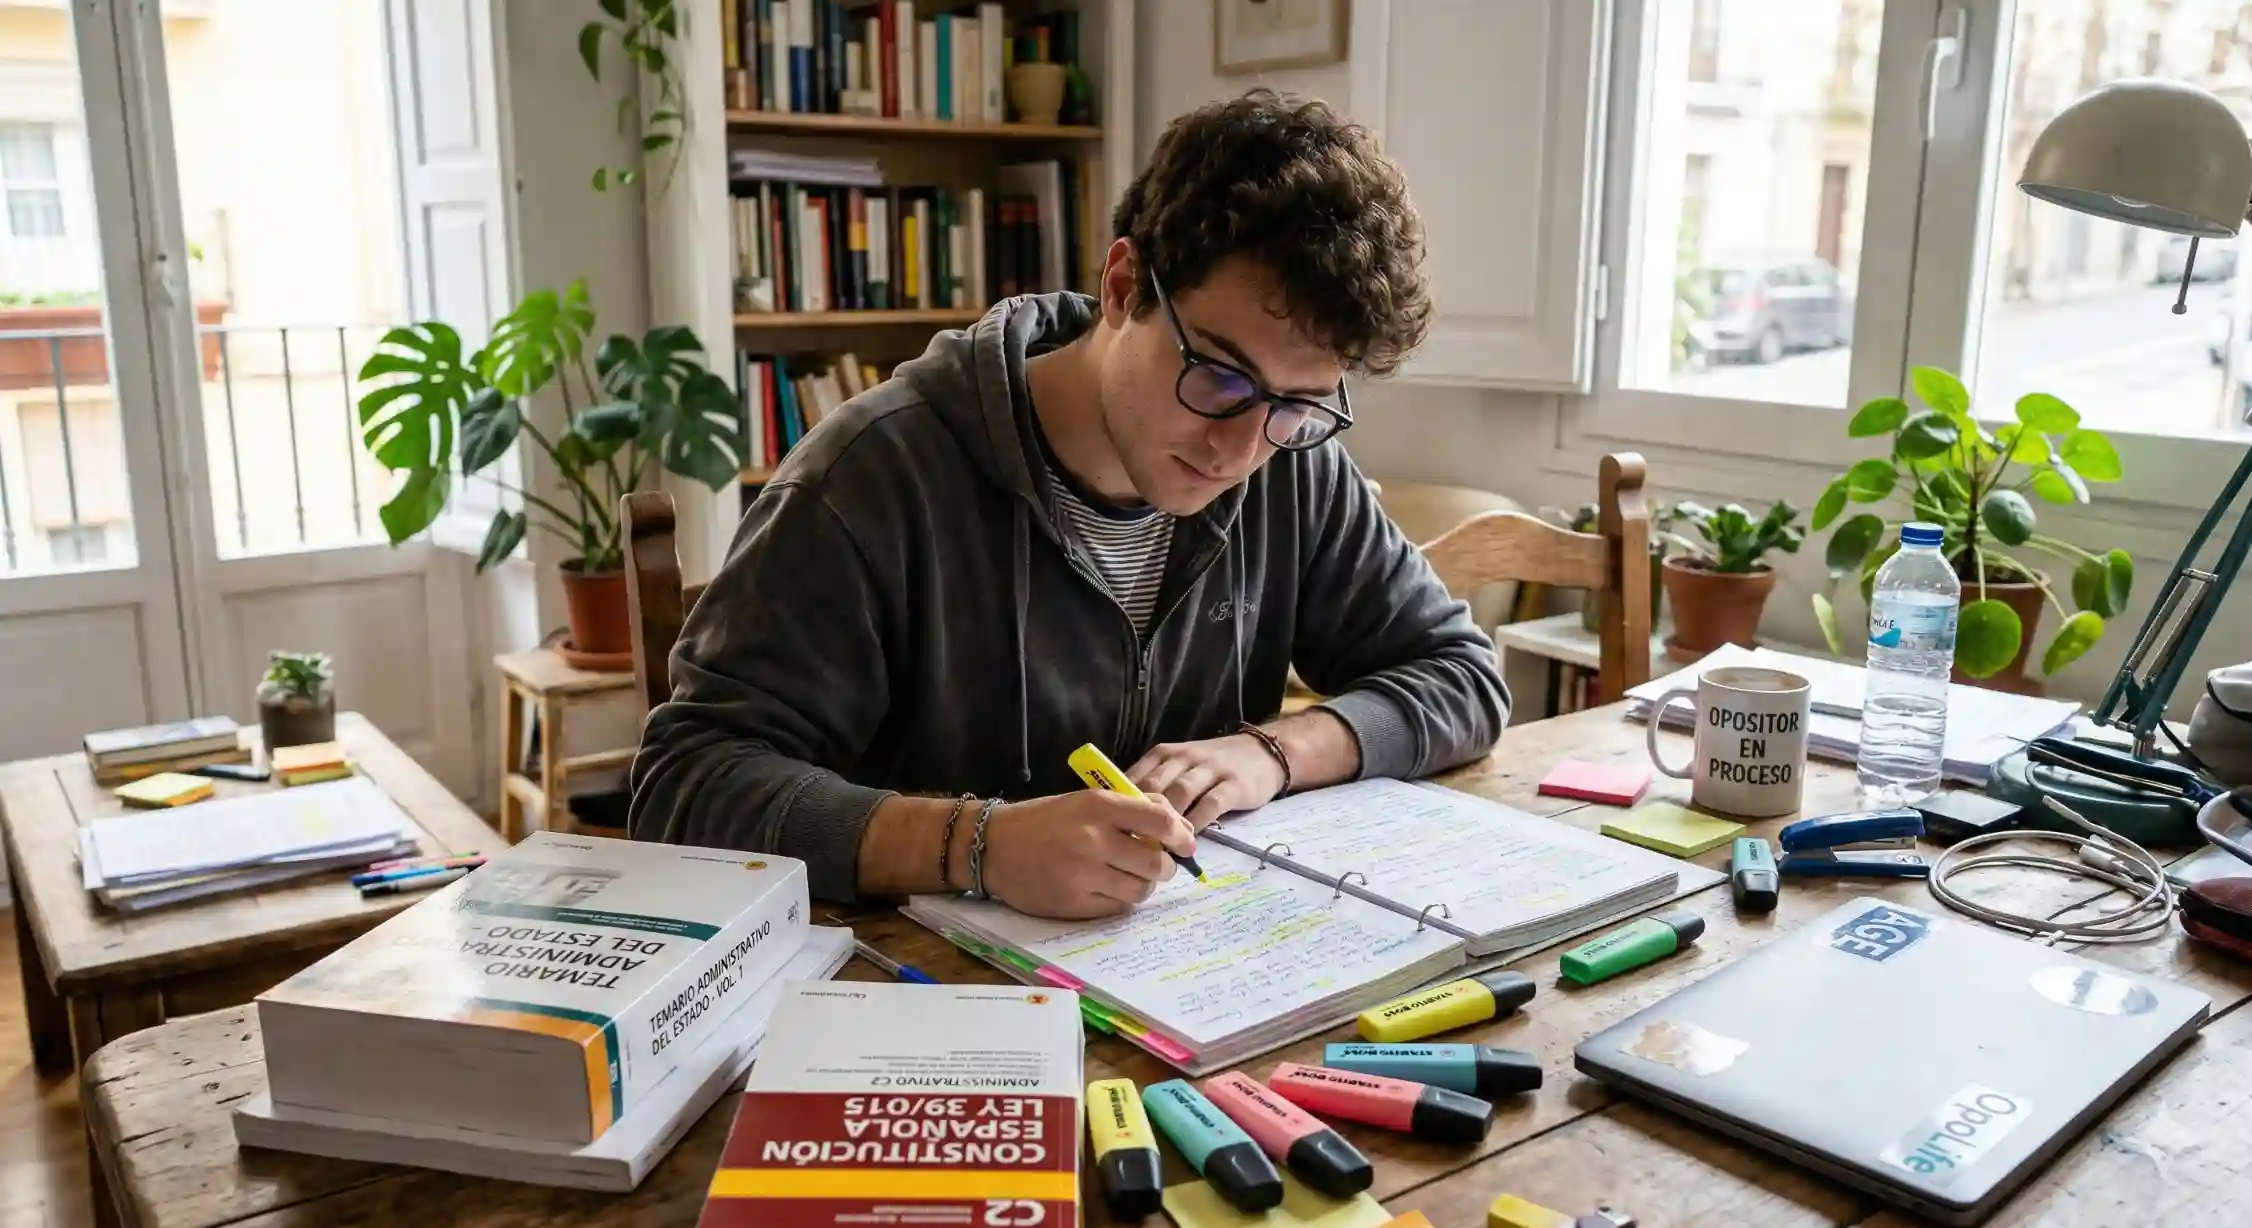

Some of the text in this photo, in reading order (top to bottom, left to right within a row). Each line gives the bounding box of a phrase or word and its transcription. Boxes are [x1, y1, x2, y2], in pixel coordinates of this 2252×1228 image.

[1709, 706, 1799, 734] OPOSITOR
[1740, 738, 1766, 759] EN
[1709, 758, 1793, 785] PROCESO
[487, 926, 603, 947] ESTADO
[612, 937, 666, 956] DEL
[1833, 911, 1925, 957] AGE
[484, 962, 620, 990] TEMARIO
[650, 920, 771, 1034] TEMARIO ADMINISTRATIVO
[651, 1028, 671, 1056] DEL
[673, 995, 710, 1038] ESTADO
[716, 975, 737, 998] VOL.
[738, 964, 744, 979] 1
[870, 1076, 891, 1086] C2
[844, 1097, 1044, 1117] LEY 39/015
[844, 1118, 1043, 1142] ESPAÑOLA
[1902, 1093, 2018, 1174] OpoLife
[762, 1140, 1046, 1166] CONSTITUCIÓN
[984, 1199, 1046, 1227] C2
